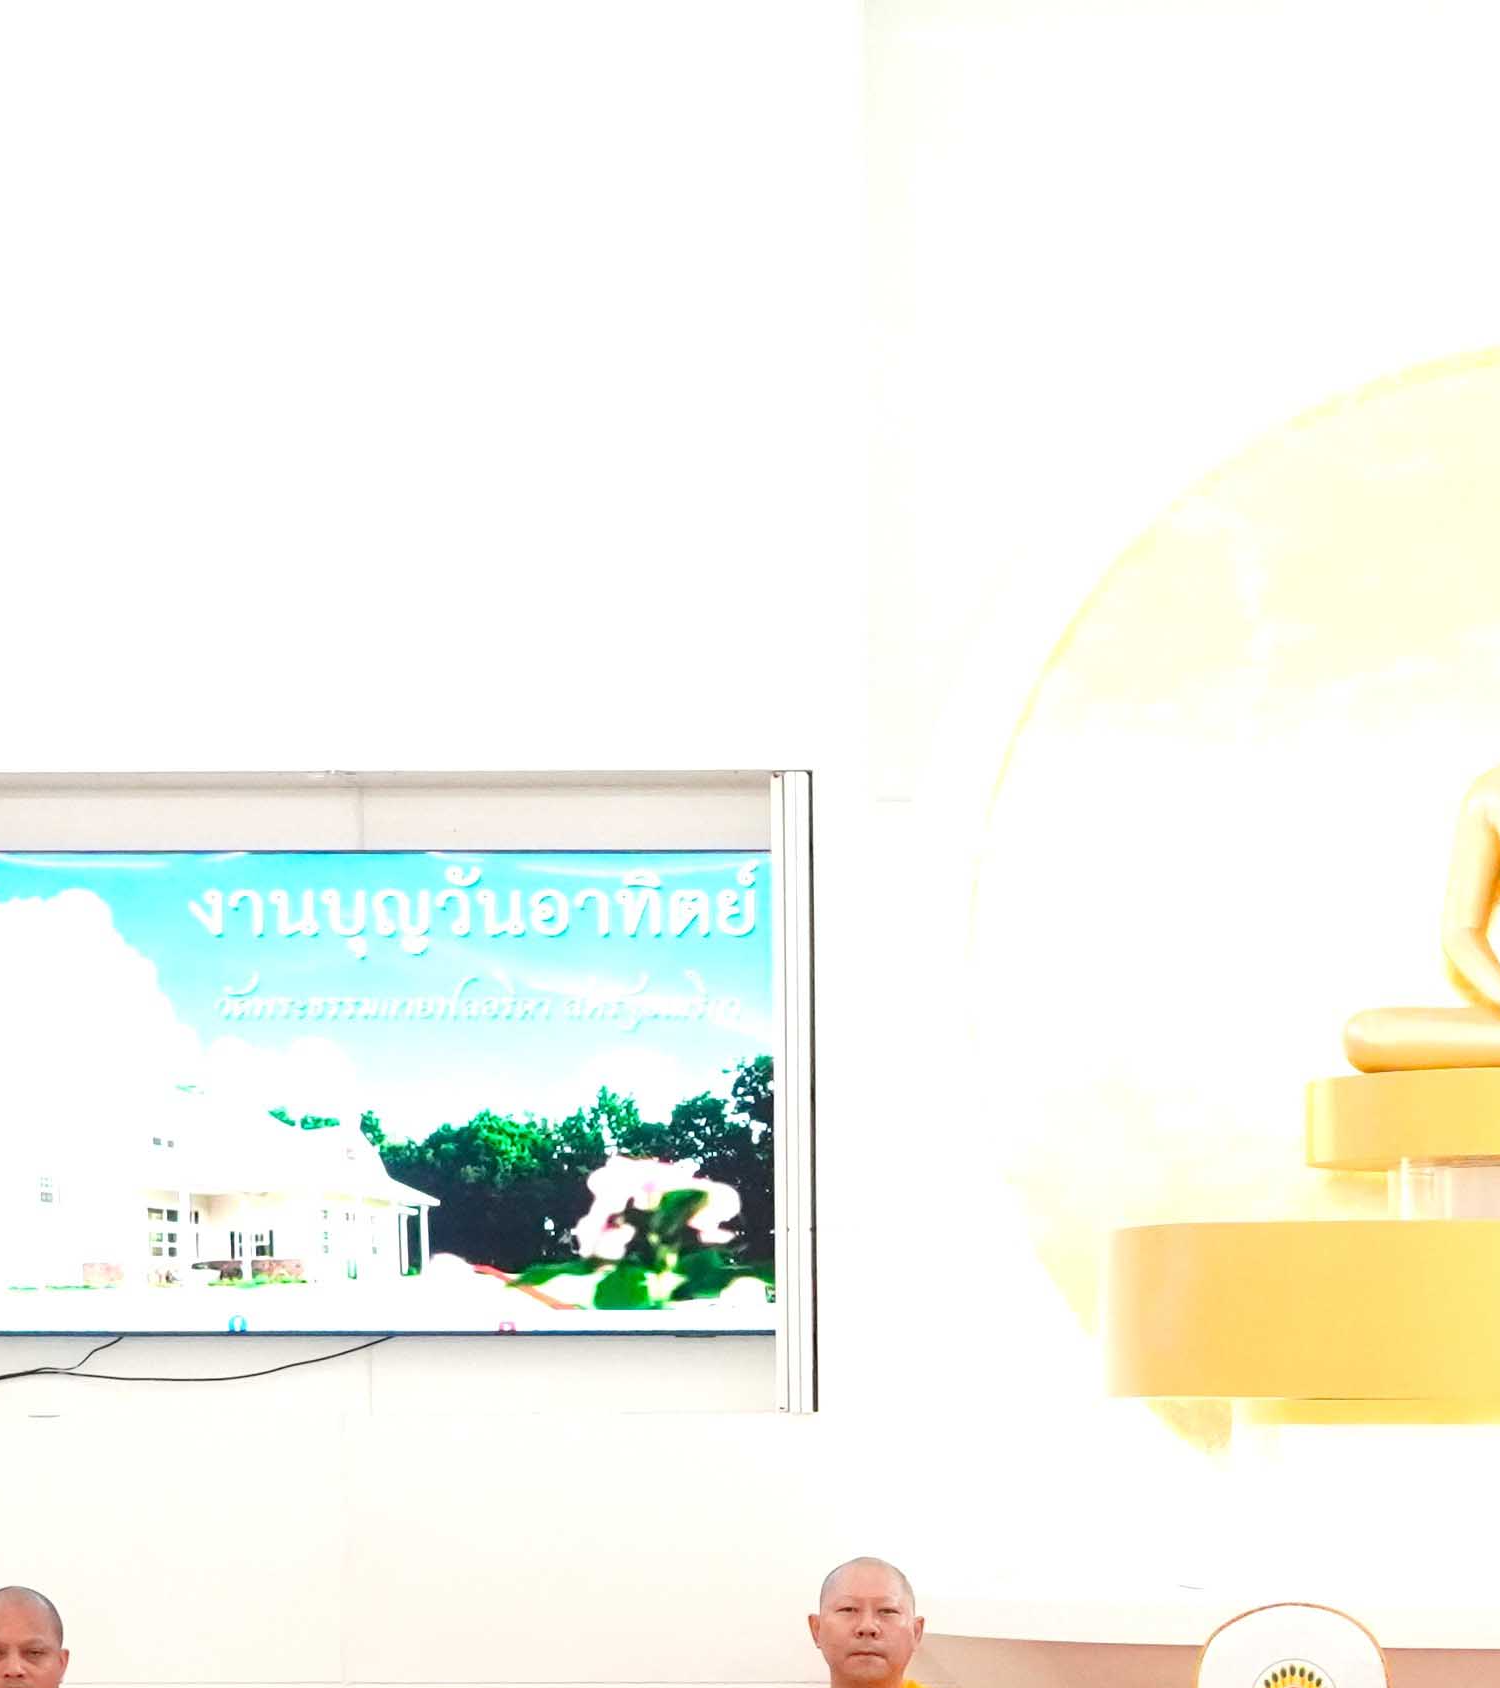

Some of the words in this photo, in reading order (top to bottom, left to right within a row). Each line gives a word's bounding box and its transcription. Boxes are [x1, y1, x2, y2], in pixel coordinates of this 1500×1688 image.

[187, 860, 759, 957] งานบุญวันอาทิตย์
